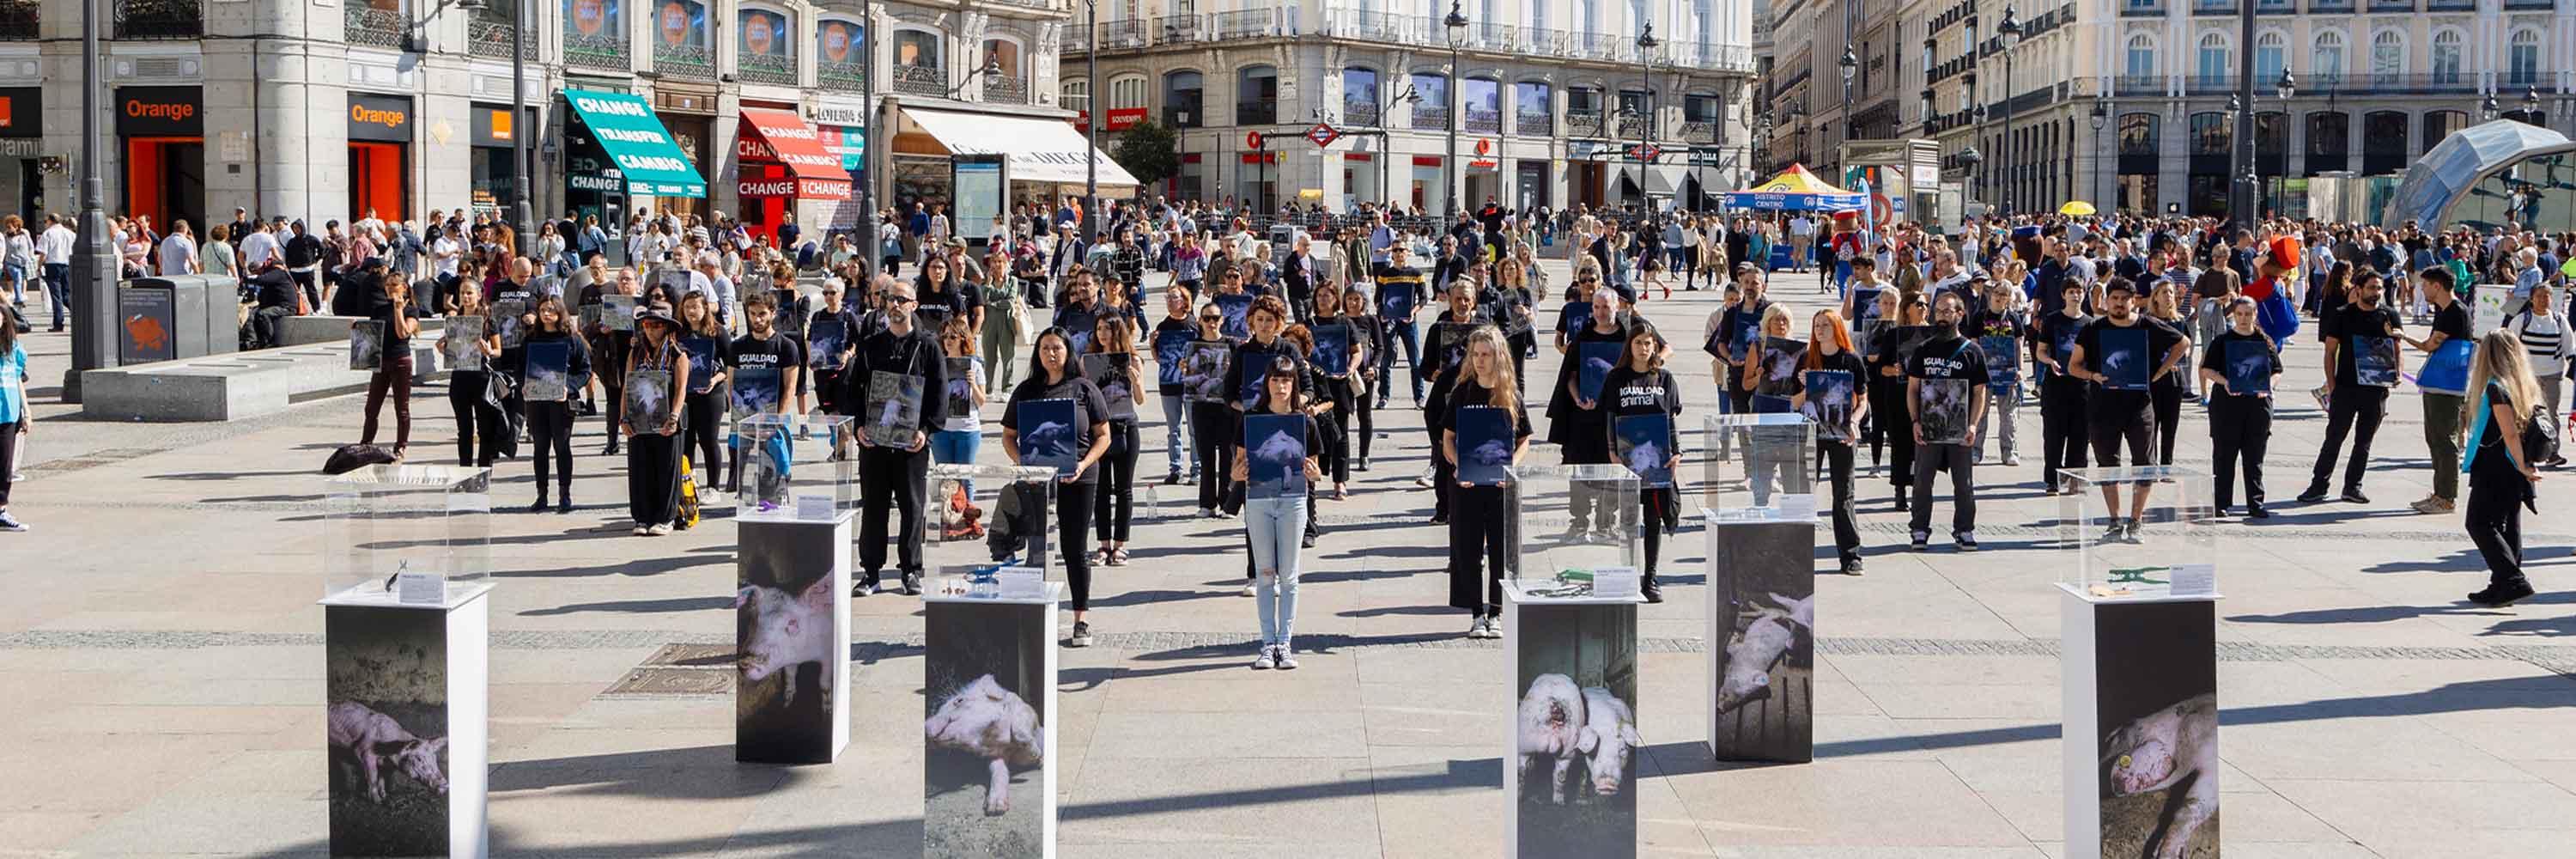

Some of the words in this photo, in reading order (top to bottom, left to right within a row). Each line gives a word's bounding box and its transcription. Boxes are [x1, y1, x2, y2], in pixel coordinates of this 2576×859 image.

[126, 100, 193, 121] Orange
[577, 98, 647, 117] CHANGE
[352, 104, 404, 128] Orange
[596, 127, 666, 144] TRANSFER
[617, 155, 686, 172] CAMBIO
[572, 176, 620, 191] CHANGE
[738, 182, 794, 195] CHANGE
[807, 182, 851, 197] CHANGE
[738, 353, 778, 363] IGUALDAD
[1619, 386, 1665, 397] IGUALDAD
[1620, 394, 1655, 408] animal
